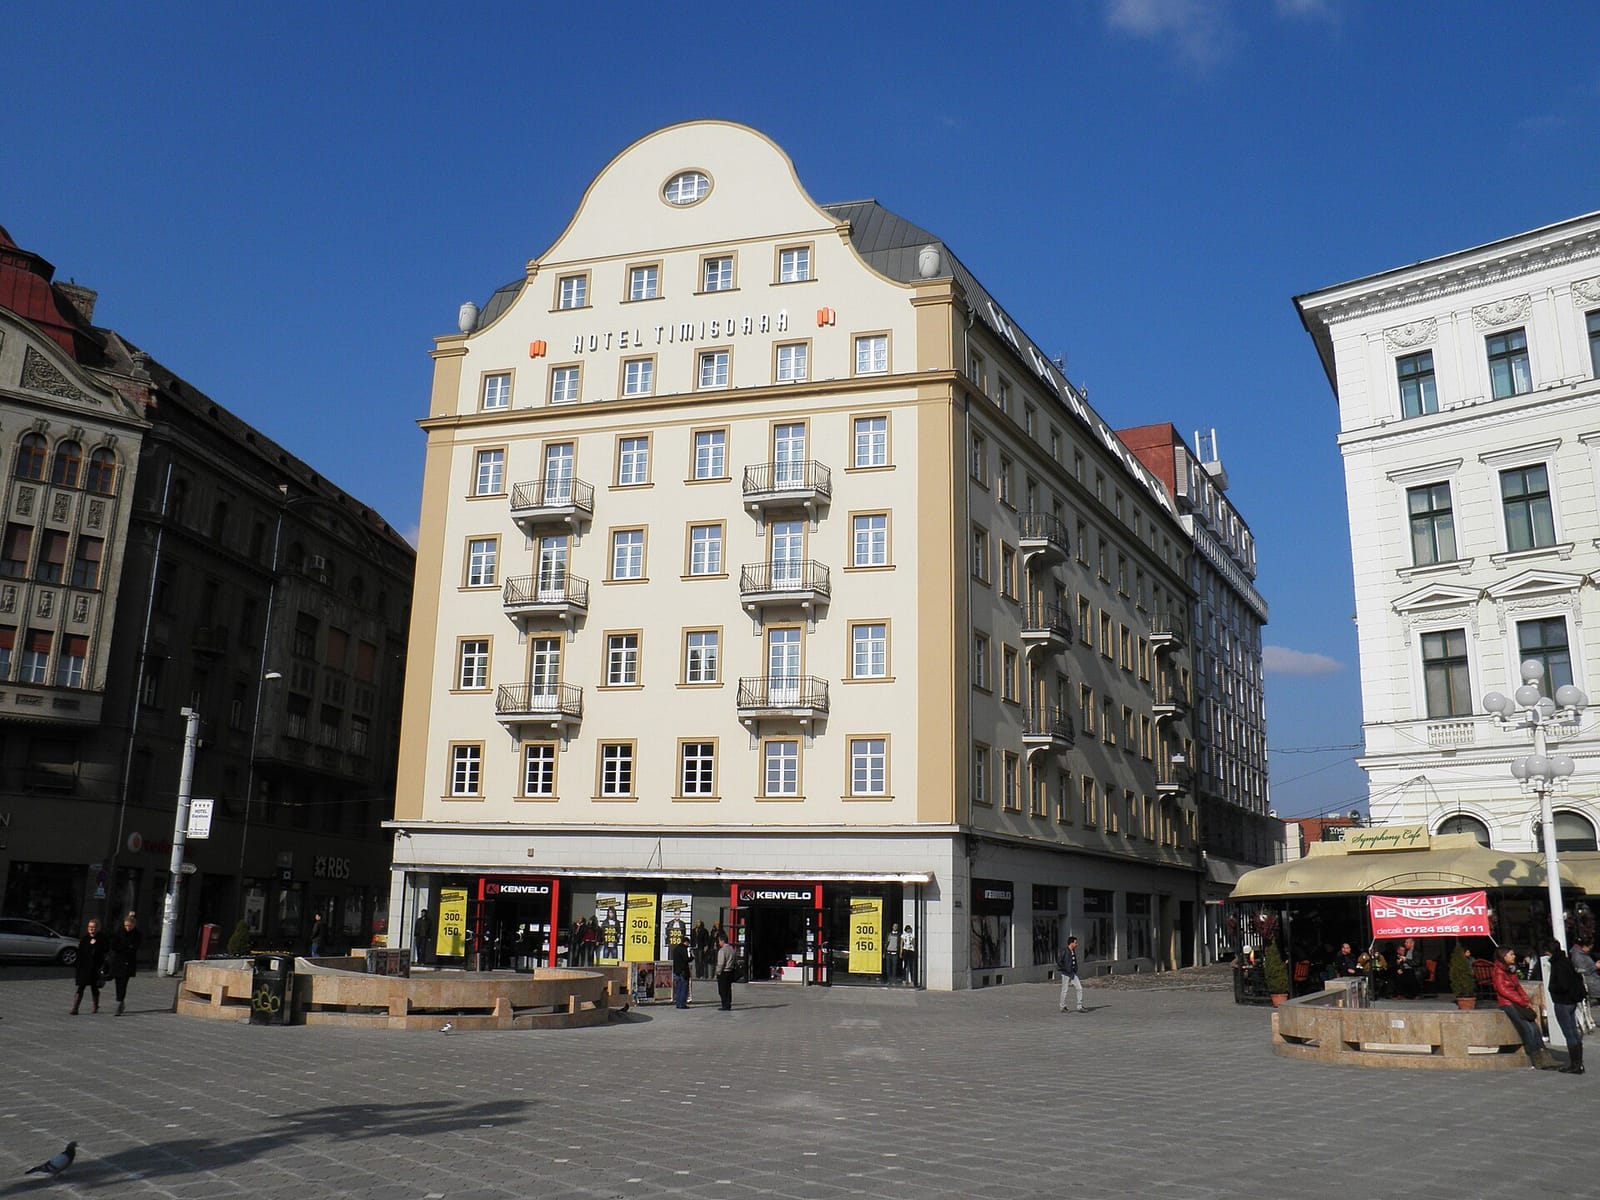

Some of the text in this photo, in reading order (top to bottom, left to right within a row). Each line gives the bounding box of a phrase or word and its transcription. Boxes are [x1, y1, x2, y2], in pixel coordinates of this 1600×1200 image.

[573, 328, 643, 354] HOTEL
[1352, 829, 1401, 849] Symphony
[327, 856, 351, 880] RBS
[500, 885, 549, 894] KENVELO
[756, 891, 812, 900] KENVELO
[1396, 896, 1456, 906] SPATIU
[444, 912, 460, 921] 300
[1374, 905, 1486, 918] DE INCHIRIAT
[632, 920, 648, 929] 300
[1404, 925, 1435, 934] 0724
[443, 926, 459, 936] 150
[856, 925, 874, 935] 300
[631, 935, 648, 944] 150
[855, 941, 874, 951] 150
